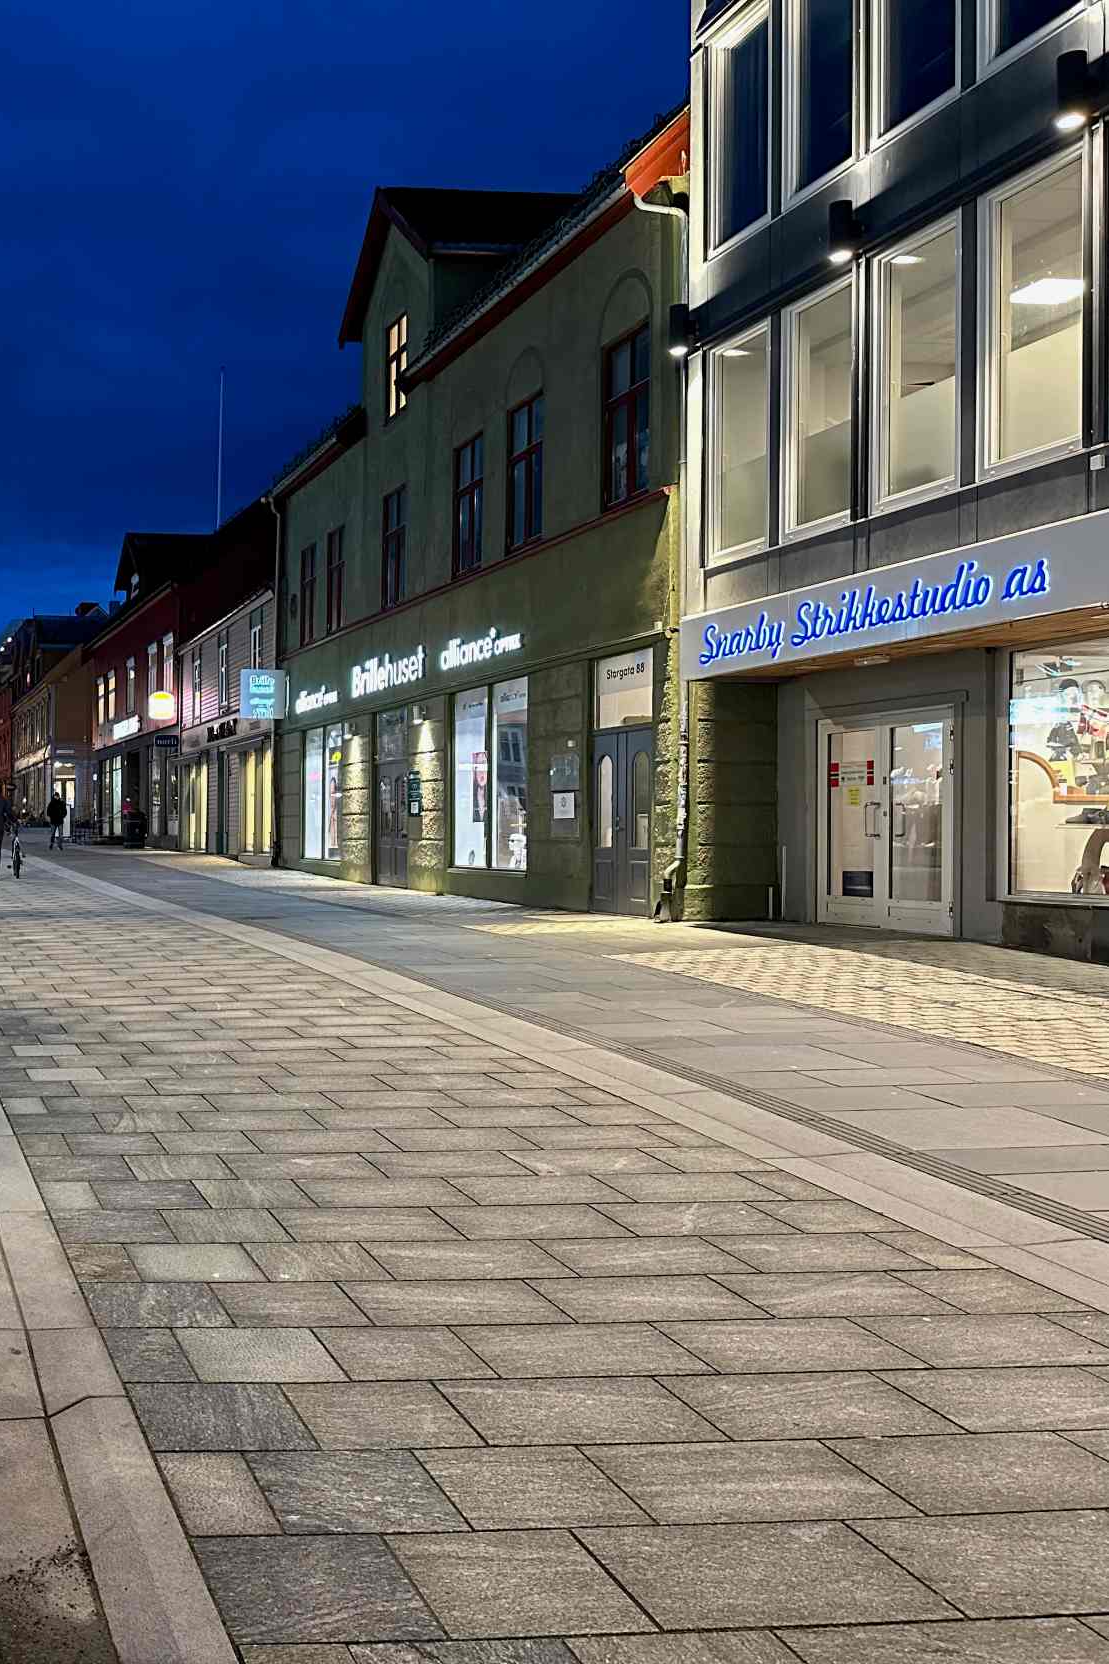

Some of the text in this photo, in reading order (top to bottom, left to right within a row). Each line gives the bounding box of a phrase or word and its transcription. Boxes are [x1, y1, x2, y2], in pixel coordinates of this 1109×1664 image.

[699, 557, 1050, 666] Snarby Strikkestudio as
[351, 644, 425, 699] Brillehuset
[441, 637, 493, 671] alliance
[606, 662, 645, 680] Storgata 88
